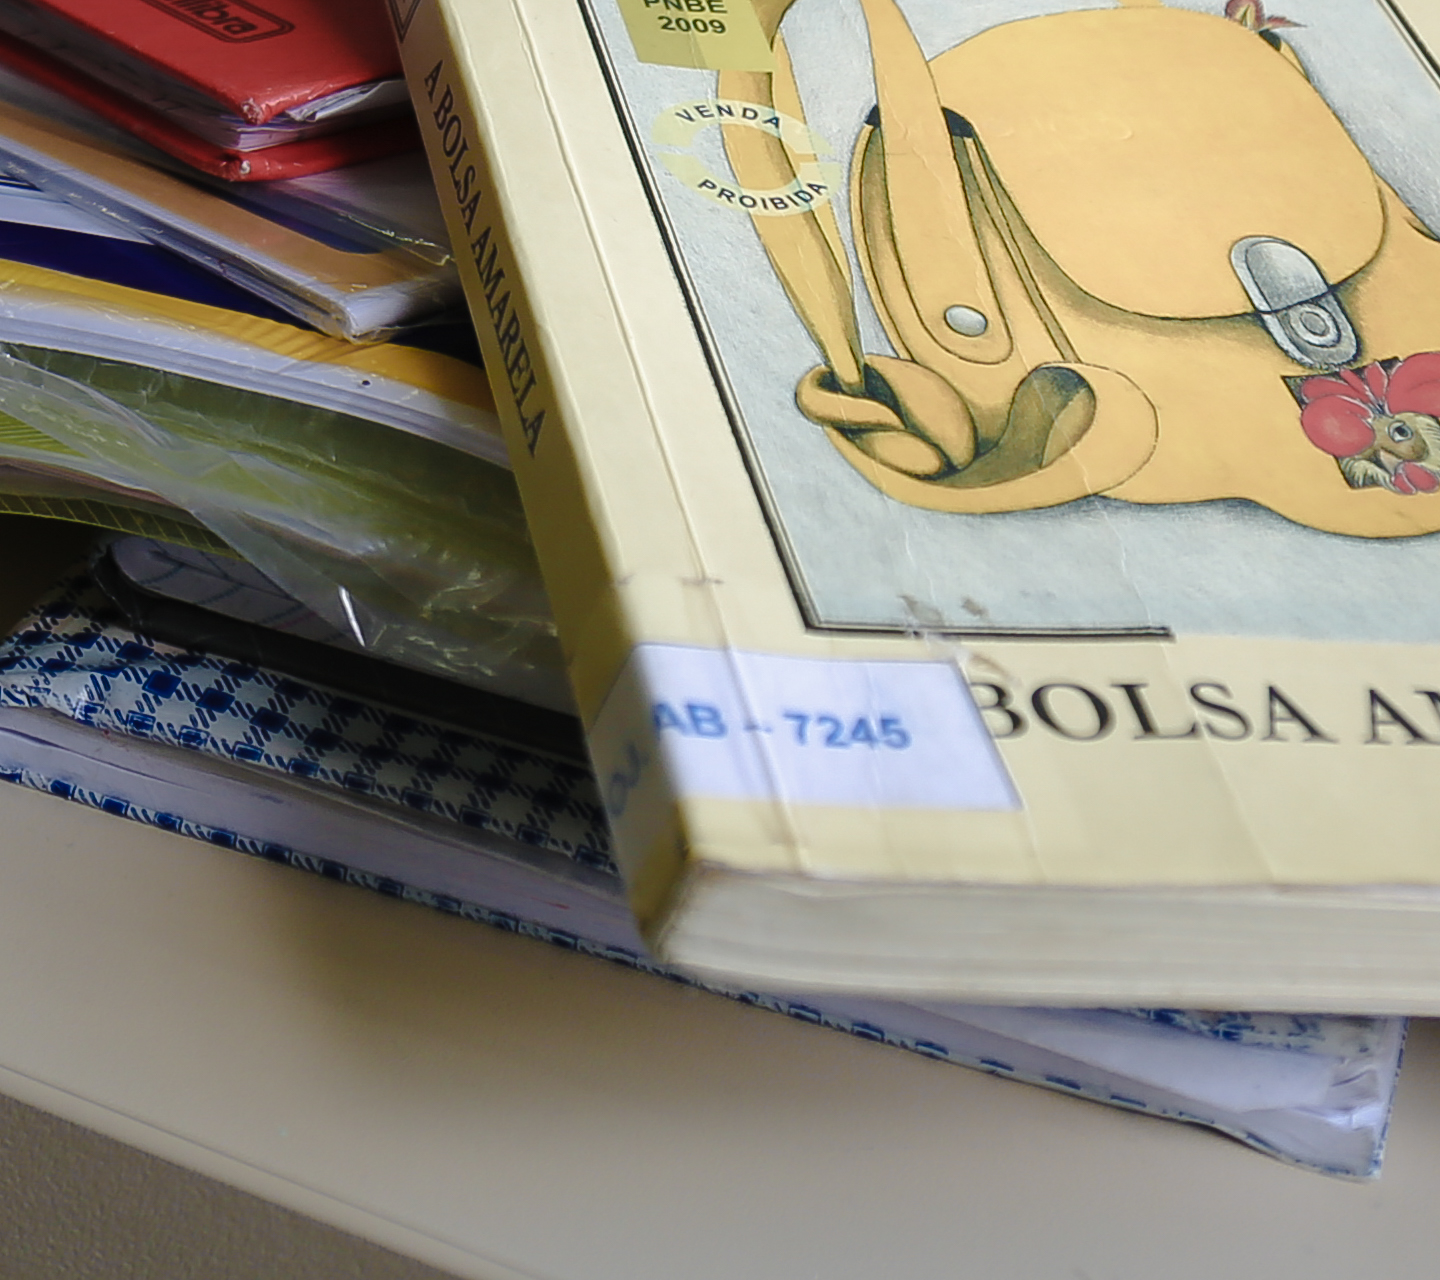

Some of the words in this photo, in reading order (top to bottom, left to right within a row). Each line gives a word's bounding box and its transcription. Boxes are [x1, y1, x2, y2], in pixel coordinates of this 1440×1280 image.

[657, 15, 727, 34] 2009
[424, 59, 443, 103] A
[675, 104, 781, 129] VENDA
[433, 83, 482, 236] BOLSA
[697, 179, 828, 211] PROIBIDA
[470, 225, 546, 459] AMARELA
[783, 711, 912, 750] 7245
[968, 681, 1339, 743] BOLSA
